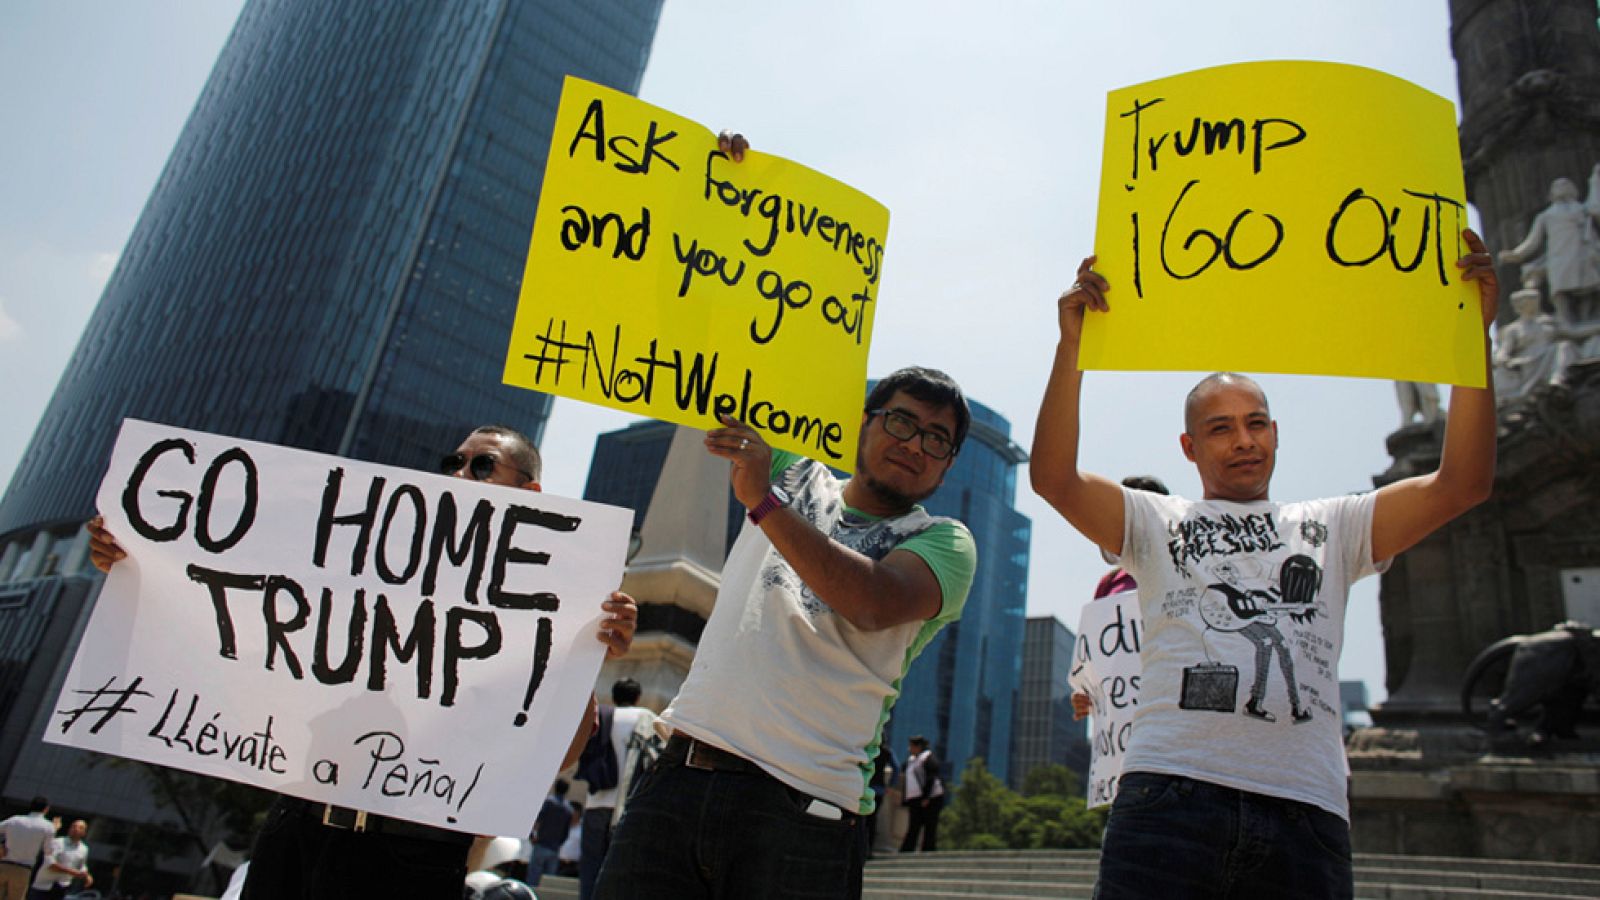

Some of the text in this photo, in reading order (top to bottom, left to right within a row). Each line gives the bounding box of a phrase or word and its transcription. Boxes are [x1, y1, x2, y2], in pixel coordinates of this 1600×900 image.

[1119, 97, 1307, 179] Trump
[560, 206, 872, 345] and you go out
[121, 438, 582, 612] GO HOME
[187, 564, 553, 727] TRUMP!
[313, 759, 339, 785] a
[354, 732, 484, 823] Peña!
